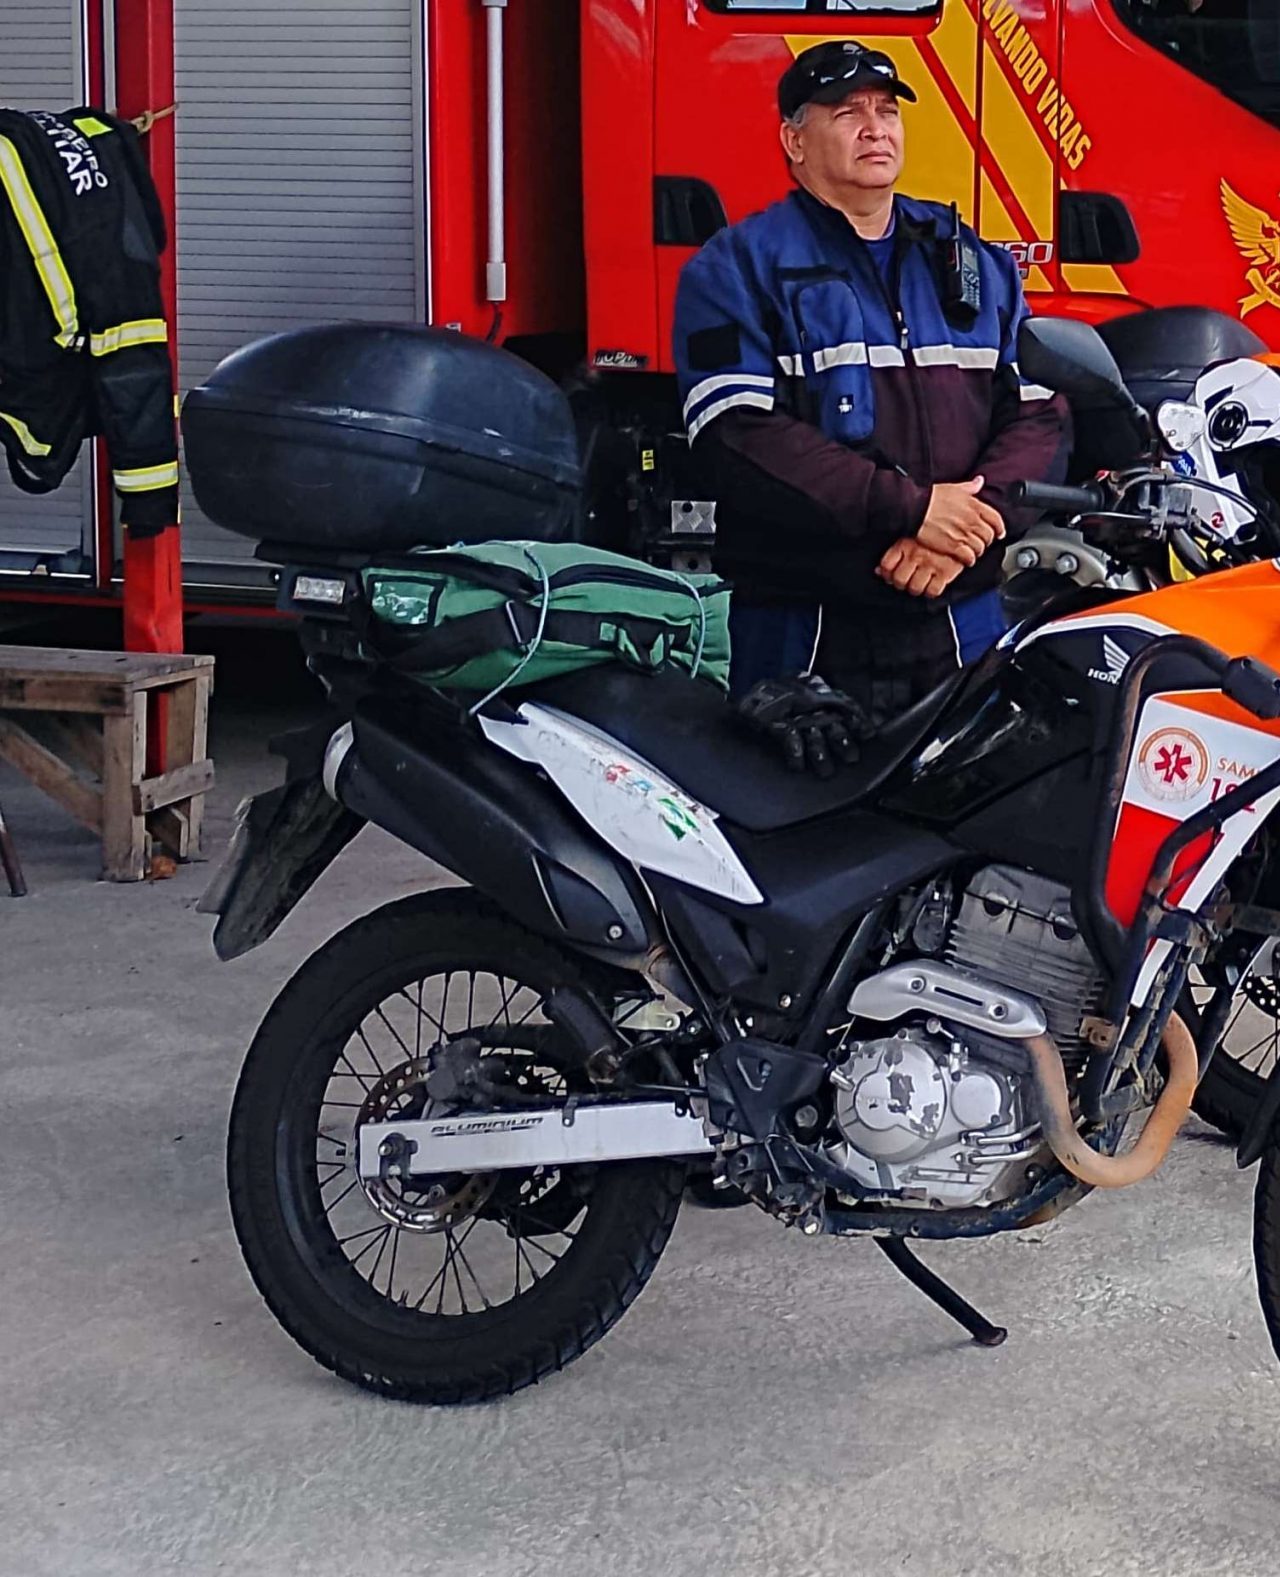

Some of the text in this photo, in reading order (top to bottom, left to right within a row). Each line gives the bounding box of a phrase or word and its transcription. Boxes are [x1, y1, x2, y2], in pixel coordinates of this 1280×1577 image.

[981, 0, 1092, 170] LVANDO VIDAS
[989, 242, 1053, 264] 60
[1087, 668, 1121, 685] HON
[1217, 757, 1261, 780] SAM
